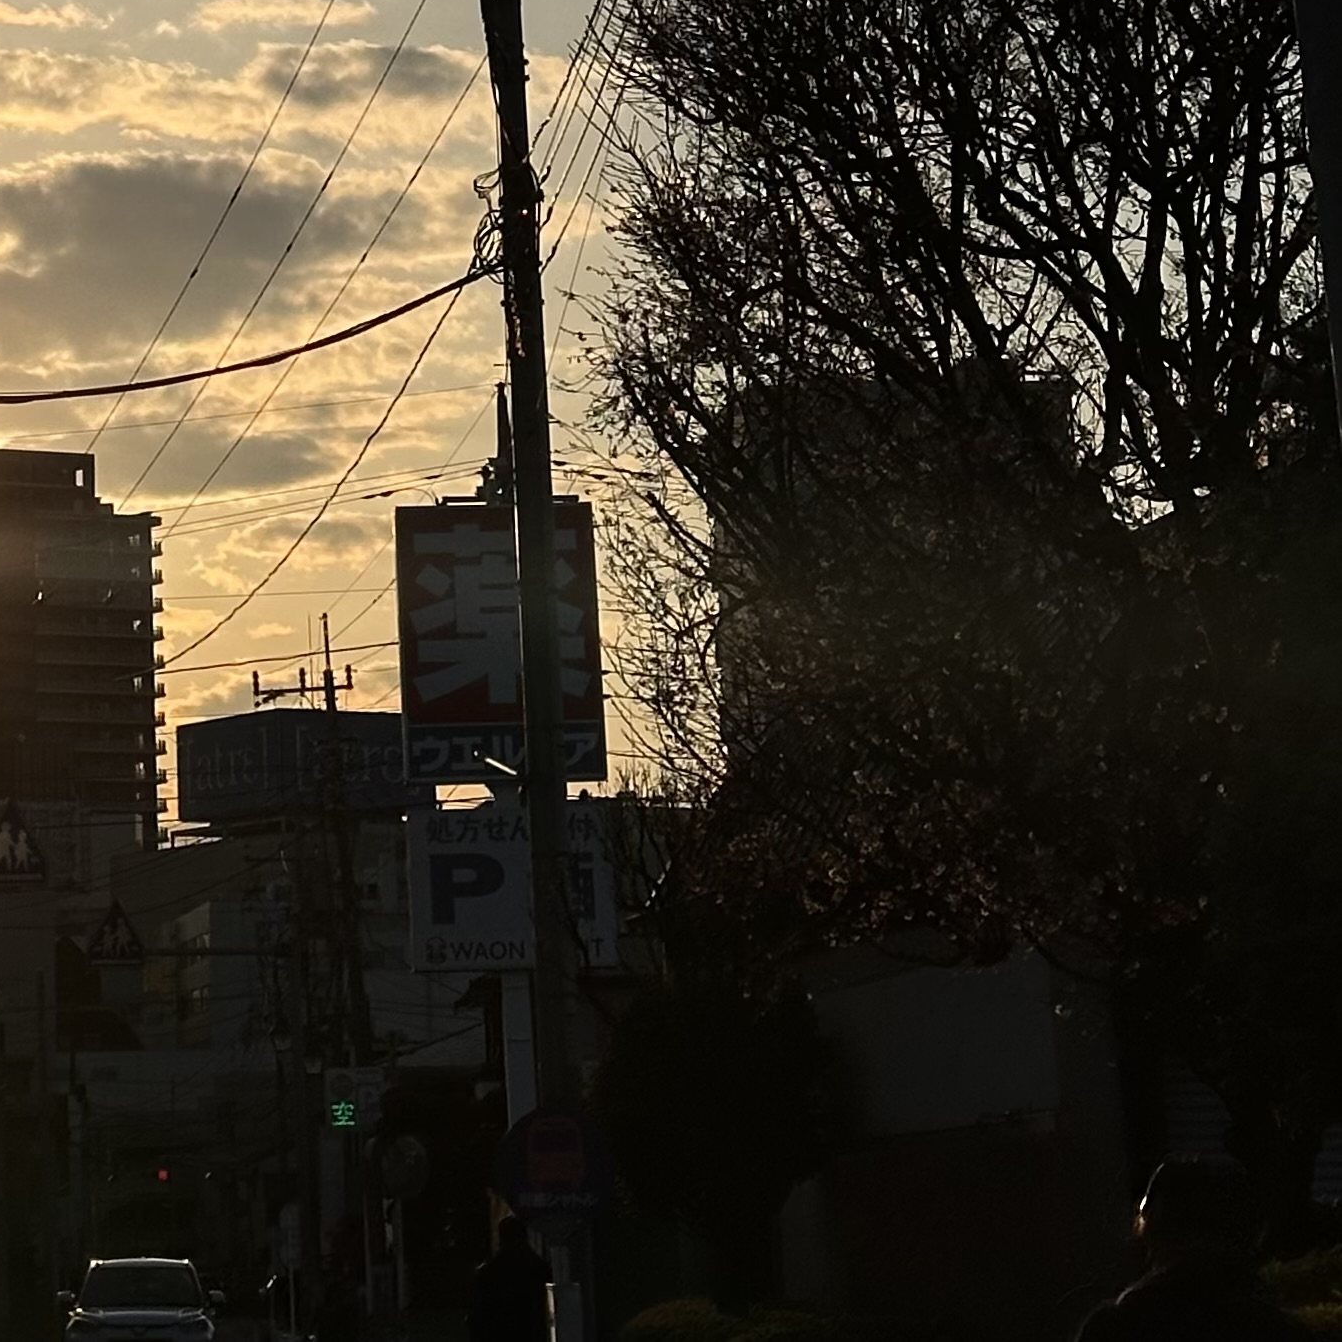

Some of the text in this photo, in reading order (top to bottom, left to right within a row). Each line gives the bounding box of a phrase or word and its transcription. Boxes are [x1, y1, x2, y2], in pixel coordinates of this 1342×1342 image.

[410, 523, 592, 704] 薬
[413, 731, 598, 774] ウエルア
[425, 812, 598, 844] 処方せん付
[429, 853, 505, 925] P
[448, 939, 526, 960] WAON
[330, 1101, 356, 1126] 空
